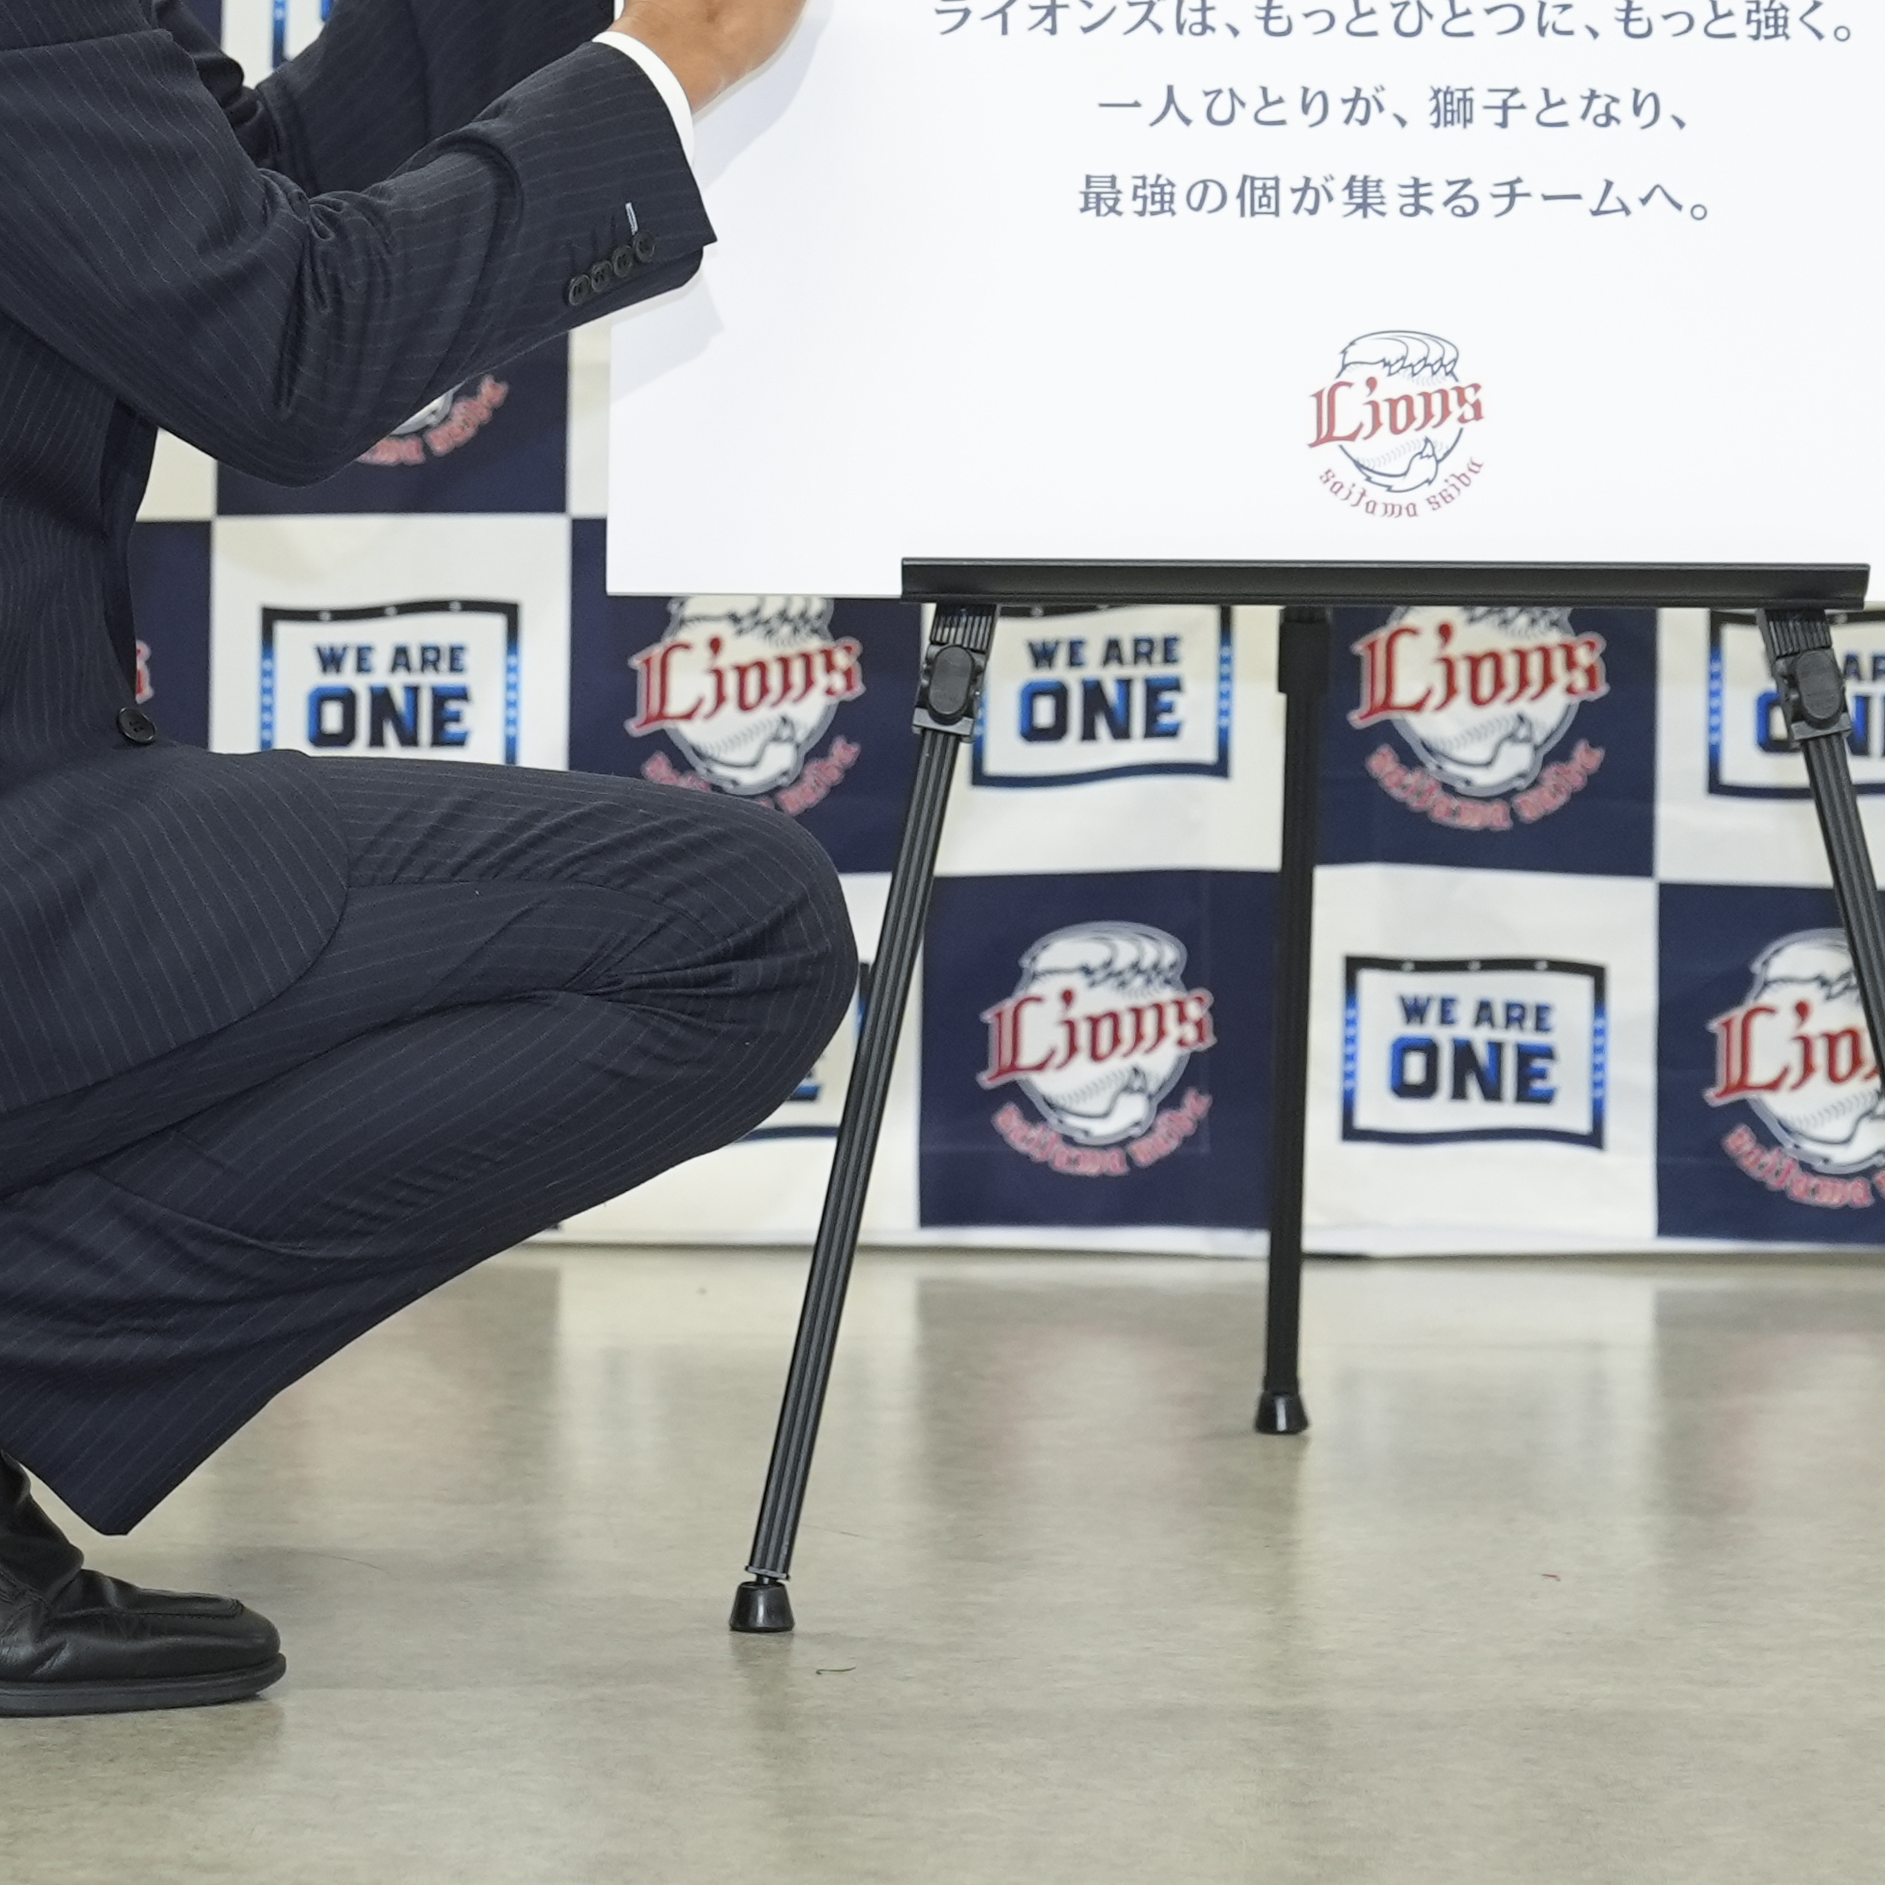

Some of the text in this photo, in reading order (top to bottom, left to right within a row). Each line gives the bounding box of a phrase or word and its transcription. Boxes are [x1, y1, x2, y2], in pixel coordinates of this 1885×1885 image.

[1098, 85, 1686, 130] 一人ひとりが、獅子となり、
[1079, 174, 1707, 221] 最強の個が集まるチームへ。
[1307, 376, 1484, 449] Lions
[1319, 468, 1420, 519] saitama
[988, 989, 1210, 1081] Lions
[1399, 995, 1552, 1034] WE ARE
[1390, 1036, 1557, 1105] ONE
